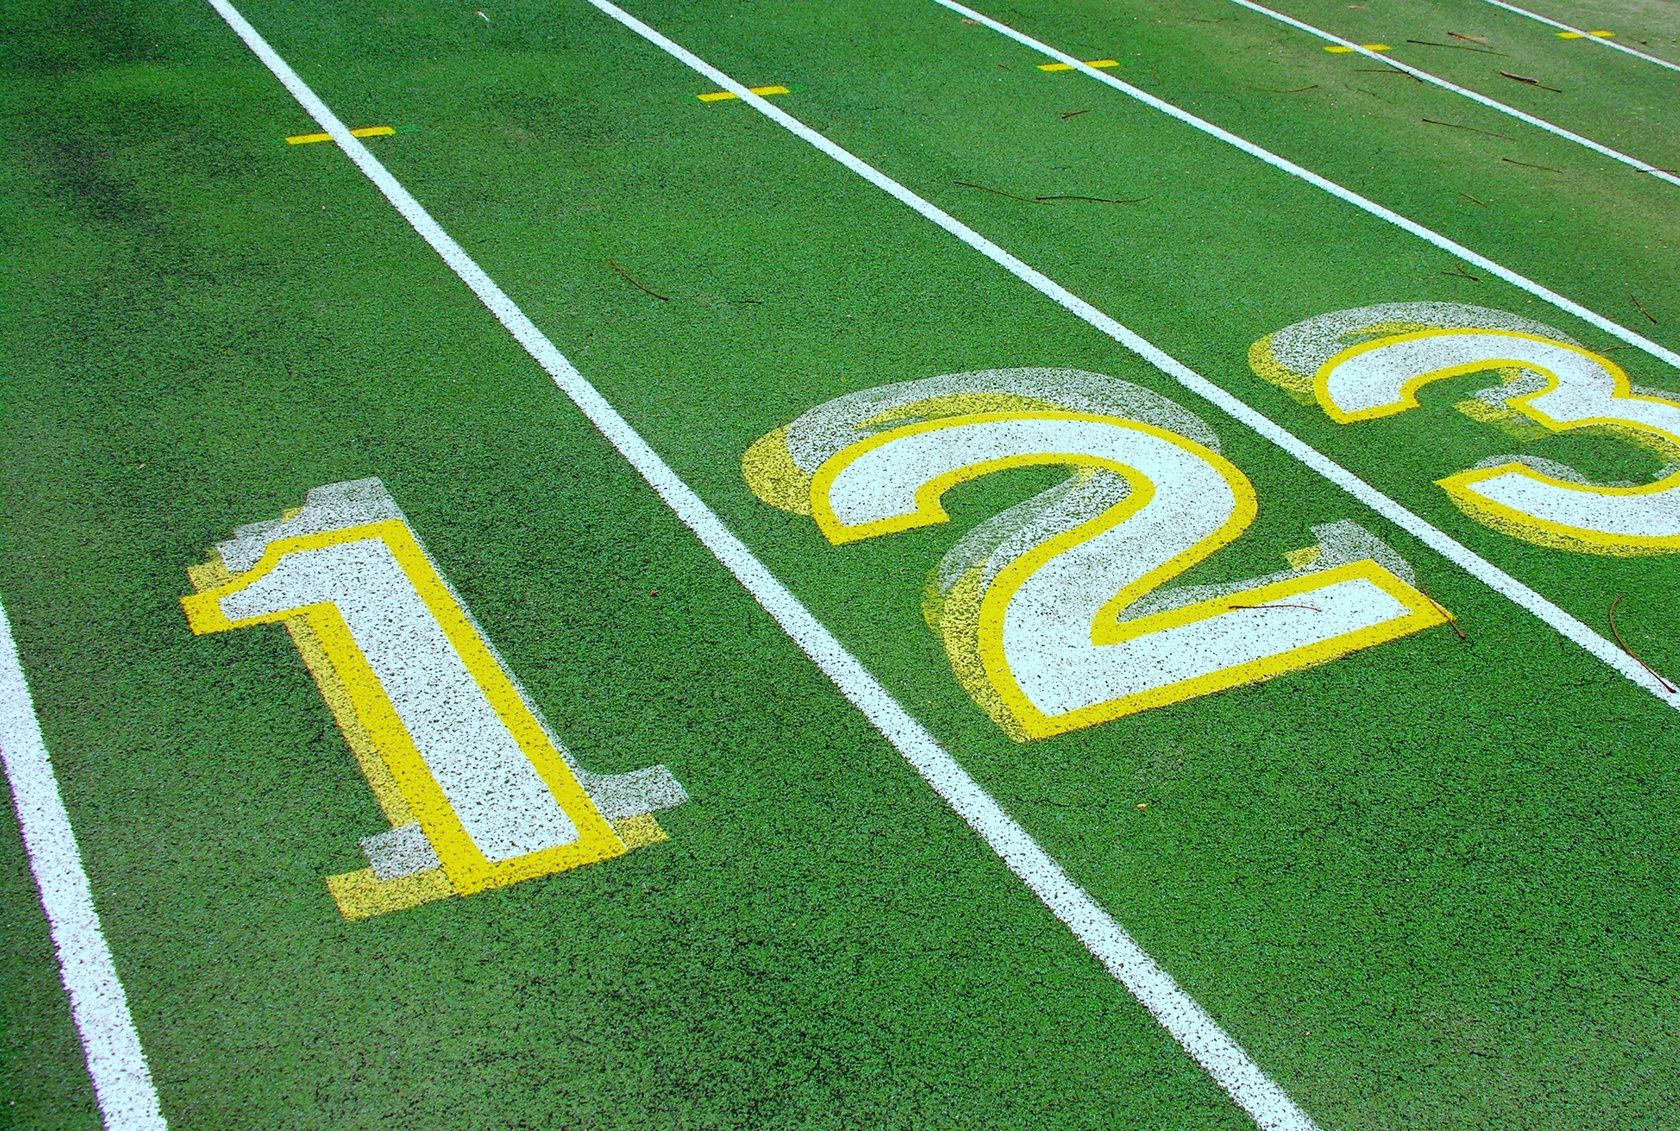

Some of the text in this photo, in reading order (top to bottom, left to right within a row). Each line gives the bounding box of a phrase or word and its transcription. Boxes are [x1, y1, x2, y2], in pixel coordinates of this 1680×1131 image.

[810, 410, 1455, 741] 2
[1313, 328, 1680, 548] 3
[180, 519, 628, 896] 1
